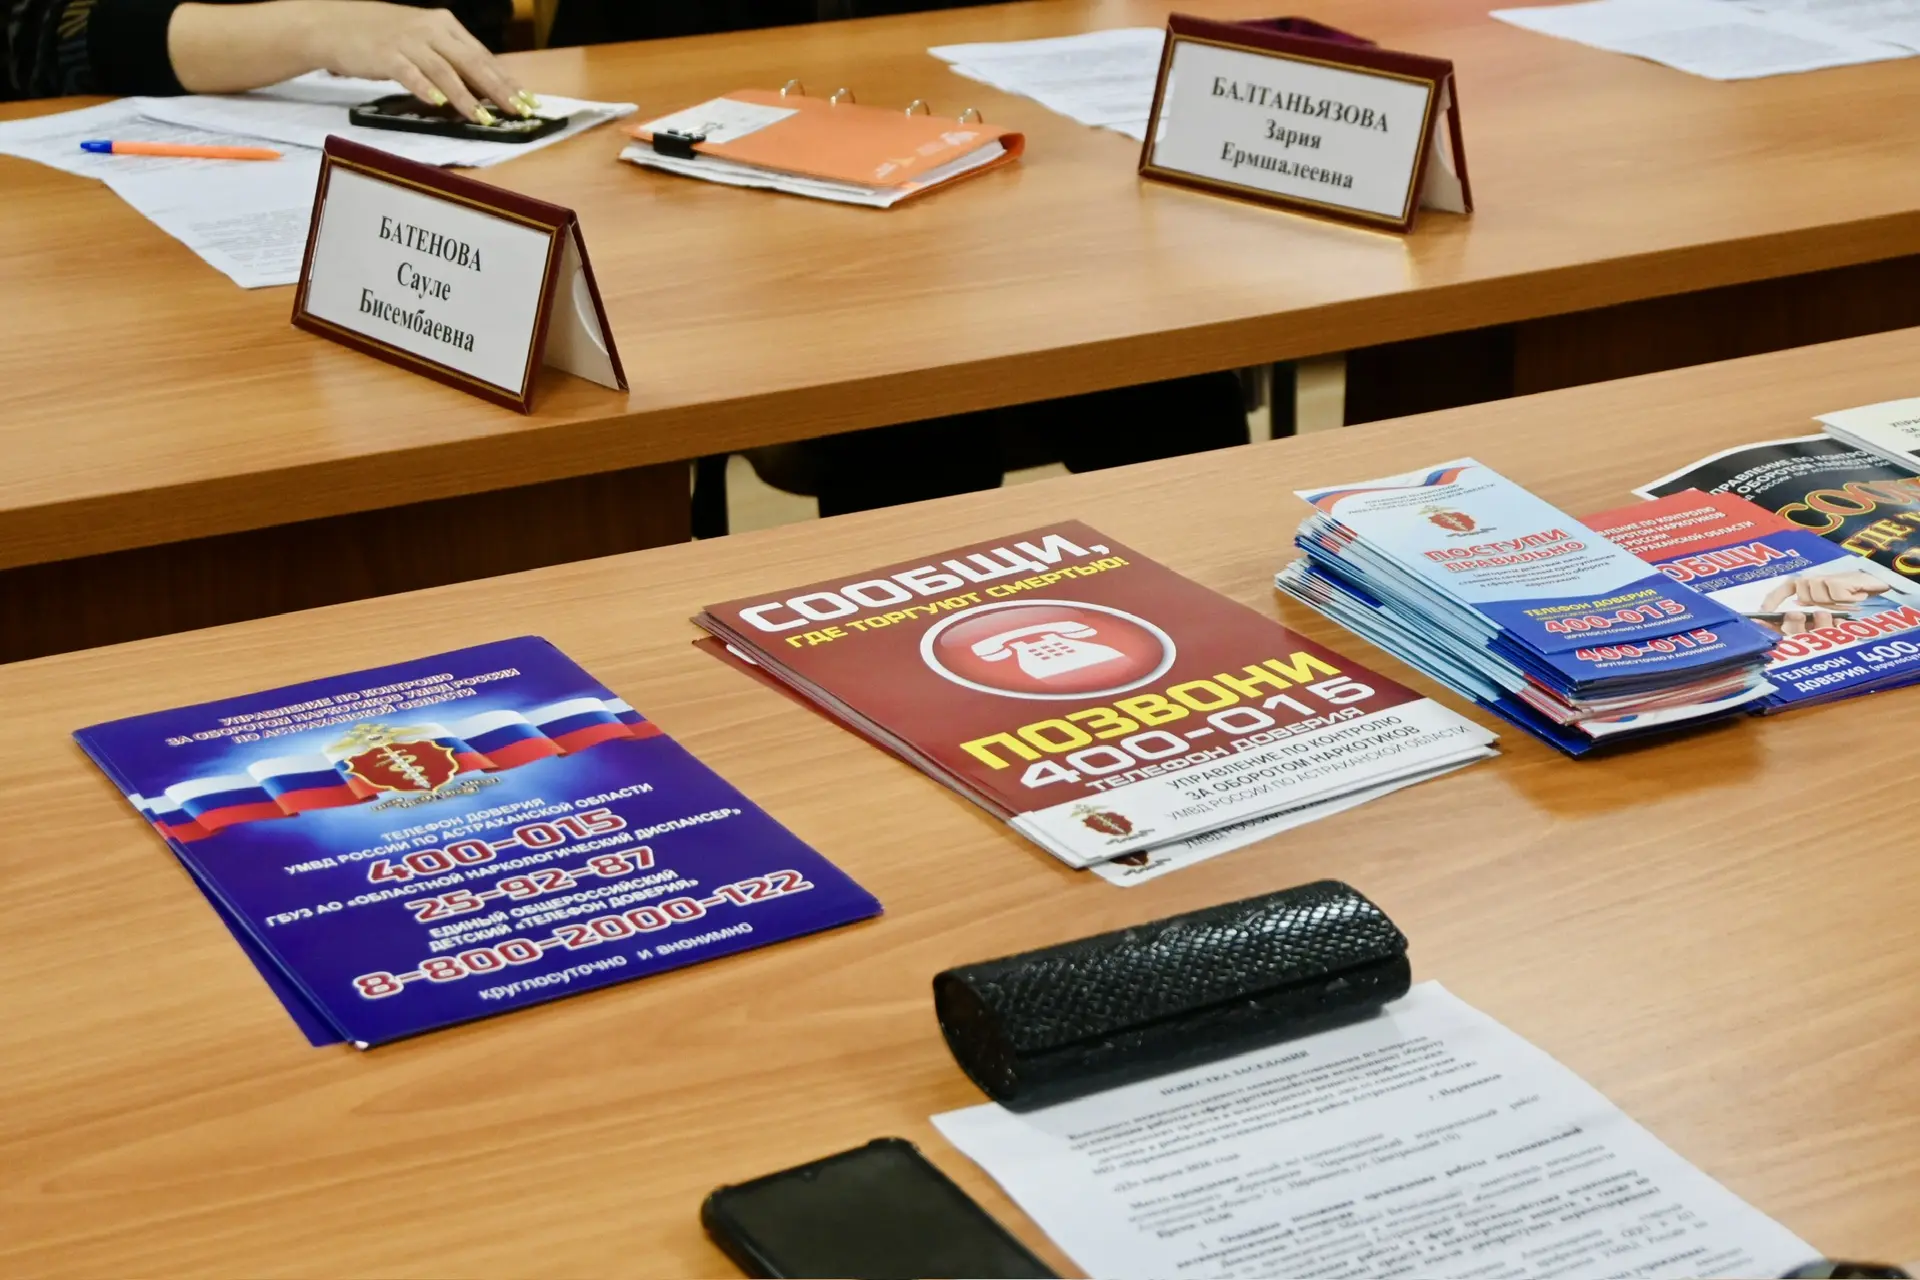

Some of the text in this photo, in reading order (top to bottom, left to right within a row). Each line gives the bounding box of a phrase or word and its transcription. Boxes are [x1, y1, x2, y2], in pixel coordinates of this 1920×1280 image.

[1211, 76, 1388, 132] БАЛТАНЬЯЗОВА
[1265, 118, 1322, 150] Зария
[1220, 141, 1354, 189] Ермшалеевна
[378, 215, 482, 272] БАТЕНОВА
[396, 261, 451, 301] Сауле
[358, 287, 475, 352] Бисембаевна
[1814, 450, 1874, 462] КОНТРО
[1423, 527, 1573, 562] ПОСТУПИ
[1656, 505, 1717, 524] КОНТРОЛЮ
[1656, 511, 1727, 532] НАРКОТИКОВ
[739, 533, 1111, 633] СООБЩИ,
[1443, 541, 1587, 574] ПРАВИЛЬНО
[785, 556, 1131, 648] ГДЕ ТОРГУЮТ СМЕРТЬЮ!
[1523, 601, 1591, 617] ТЕЛЕФОН
[1592, 588, 1657, 608] ДОВЕРИЯ
[1544, 598, 1687, 635] 400-015
[1575, 628, 1719, 664] 400-015
[1771, 655, 1852, 683] ТЕЛЕФОН
[165, 667, 521, 747] ЗА ОБОРОТОМ НАРКОТИКОВ УМВД РОССИИ
[218, 672, 454, 727] УПРАВЛЕНИЕ ПО КОНТРОЛЮ
[1793, 664, 1869, 693] ДОВЕРИЯ
[232, 687, 477, 745] ПО АСТРАХАНСКОЙ ОБЛАСТИ
[959, 650, 1342, 770] ПОЗВОНИ
[1018, 675, 1376, 790] 400-015
[1083, 706, 1366, 792] ТЕЛЕФОН ДОВЕРИЯ
[1166, 714, 1403, 790] УПРАВЛЕНИЕ ПО КОНТРОЛЮ
[1166, 802, 1212, 822] УМВД
[1212, 783, 1273, 809] РОССИИ
[1274, 775, 1298, 791] ПО
[1297, 741, 1404, 782] АСТРАХАНСКОЙ
[1402, 724, 1472, 755] ОБЛАСТИ
[1184, 724, 1421, 803] ЗА ОБОРОТОМ НАРКОТИКОВ
[284, 782, 655, 876] УМВД РОССИИ ПО АСТРАХАНСКОЙ ОБЛАСТИ
[366, 807, 628, 885] 400-015
[380, 798, 545, 843] ТЕЛЕФОН ДОВЕРИЯ
[265, 806, 743, 929] ГБУЗ АО «ОБЛАСТНОЙ НАРКОЛОГИЧЕСКИЙ ДИСПАНСЕР»
[403, 845, 657, 924] 25-92-87
[427, 868, 679, 939] ЕДИНЫЙ ОБЩЕРОССИЙСКИЙ
[427, 877, 700, 954] ДЕТСКИЙ «ТЕЛЕФОН ДОВЕРИЯ»
[352, 868, 815, 1001] 8-800-2000-122
[478, 954, 628, 1002] круглосуточно
[656, 921, 754, 956] анонимно
